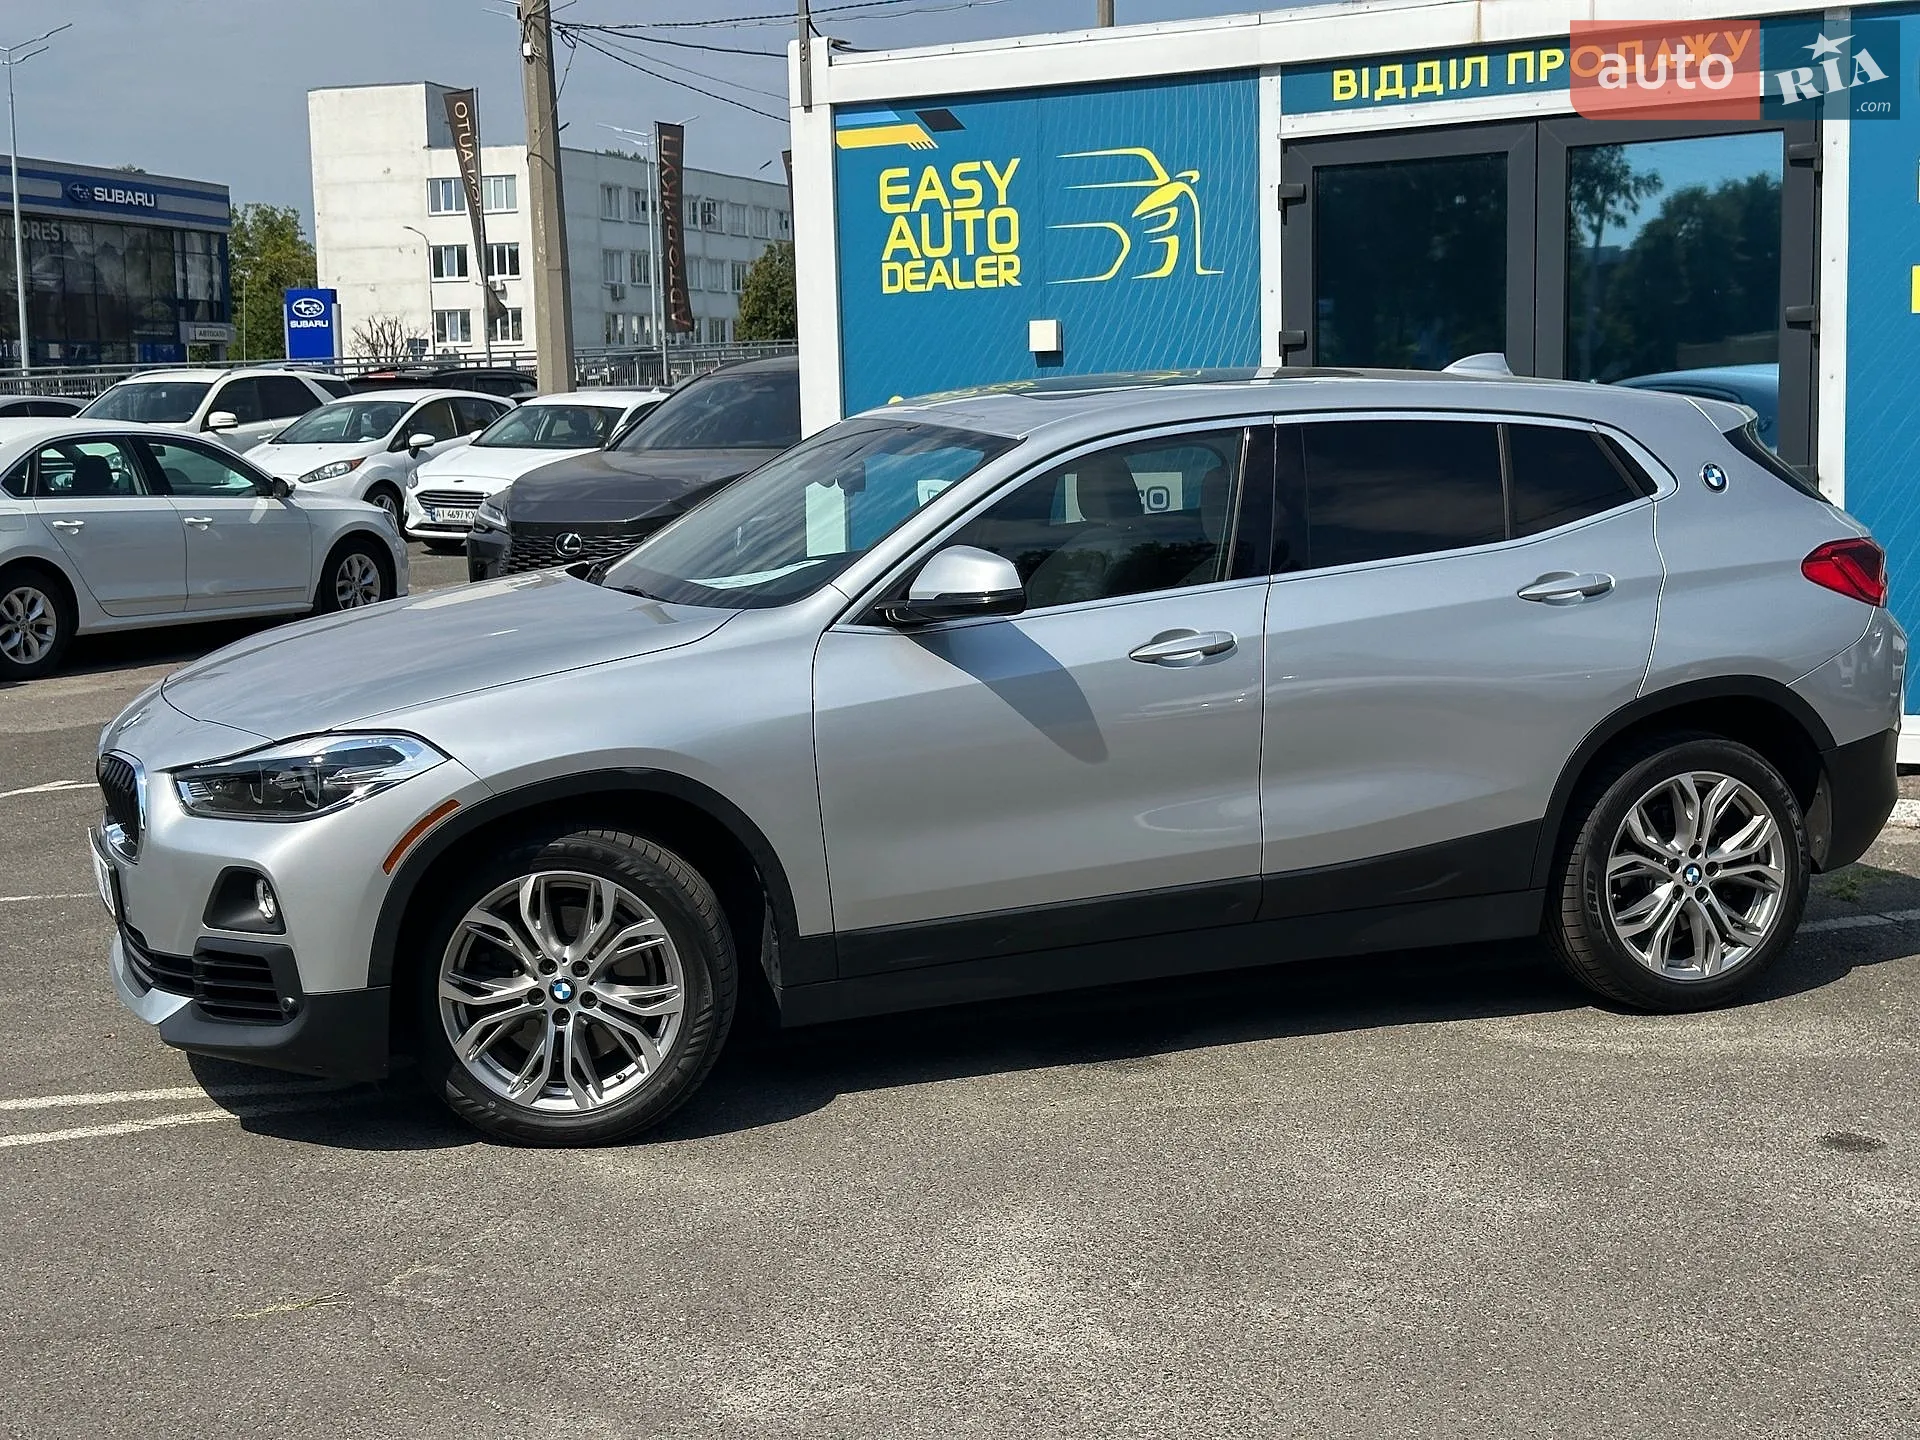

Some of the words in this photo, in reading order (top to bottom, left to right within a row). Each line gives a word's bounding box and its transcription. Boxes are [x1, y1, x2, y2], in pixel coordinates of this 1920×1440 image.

[1332, 54, 1489, 102] ВІДДІЛ
[1507, 29, 1753, 85] ПРОДАЖУ
[93, 187, 155, 207] SUBARU
[879, 158, 1021, 214] EASY
[881, 207, 1020, 261] AUTO
[881, 254, 1022, 294] DEALER
[290, 320, 329, 328] SUBARU
